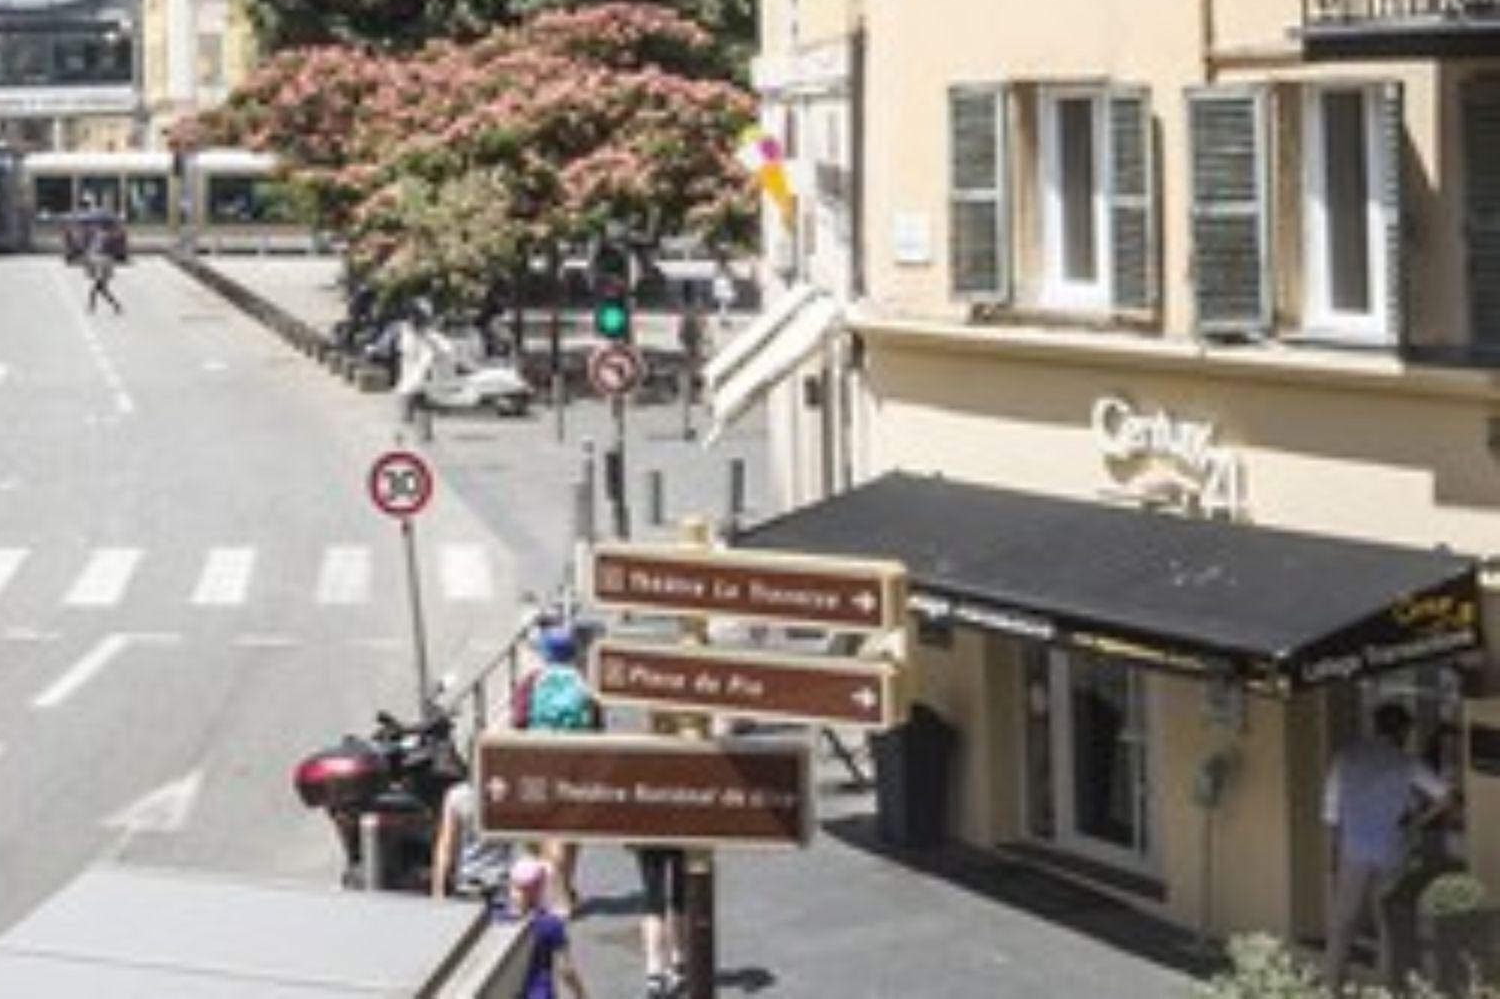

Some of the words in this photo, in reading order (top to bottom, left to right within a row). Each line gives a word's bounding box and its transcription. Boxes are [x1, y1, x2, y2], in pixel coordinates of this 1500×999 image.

[1090, 396, 1214, 470] Century
[384, 468, 418, 501] 30
[713, 575, 740, 599] La
[628, 664, 687, 691] Place
